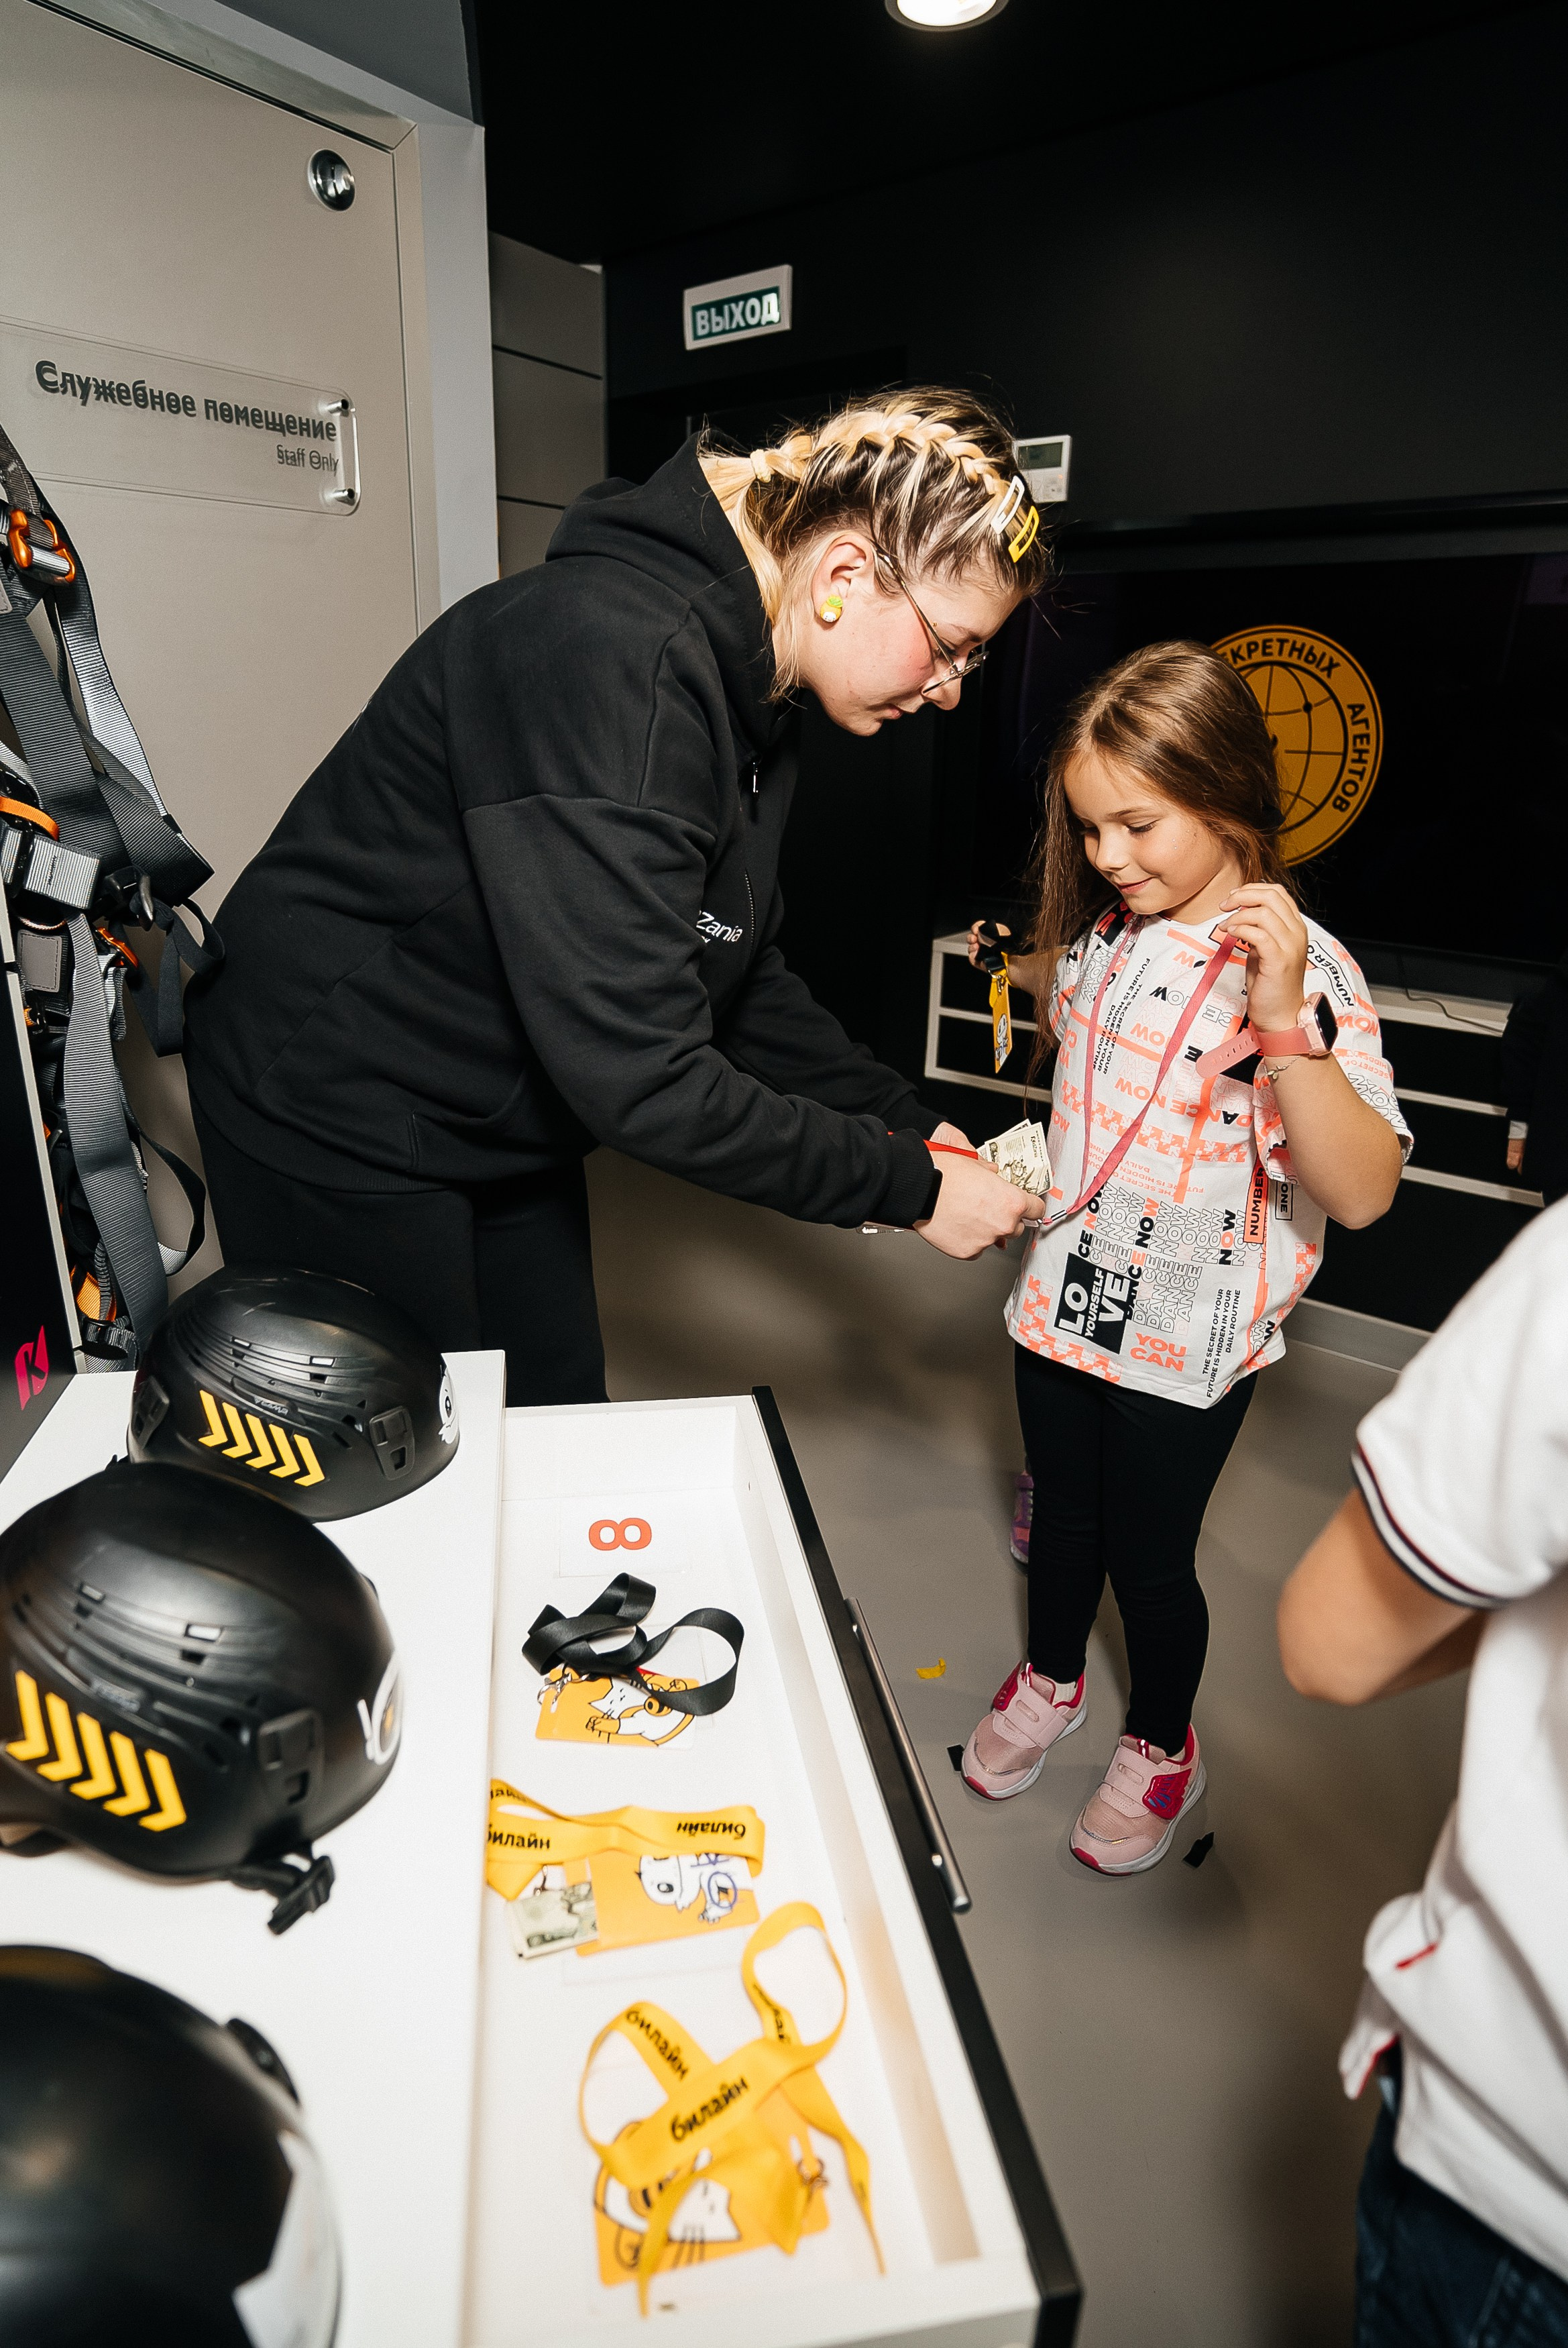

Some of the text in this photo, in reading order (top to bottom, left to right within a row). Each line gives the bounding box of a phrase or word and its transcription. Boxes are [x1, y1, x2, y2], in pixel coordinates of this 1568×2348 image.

[695, 292, 780, 336] ВЫХОД
[35, 360, 337, 442] Служебное помещение
[277, 445, 339, 477] Staff Only
[1221, 638, 1371, 814] КРЕТНЫХ АГЕНТОВ
[696, 911, 743, 943] Zania
[1128, 958, 1151, 992] FUTURE
[1131, 983, 1143, 1000] THE
[1105, 1005, 1115, 1029] DAILY
[1108, 1002, 1125, 1035] HIDDEN
[1115, 1002, 1131, 1036] SECRET
[1097, 1047, 1109, 1071] YOUR
[1103, 1049, 1113, 1075] YOUR
[1250, 1167, 1266, 1236] NUMBER
[1280, 1183, 1288, 1213] ONE
[1219, 1209, 1236, 1265] NOW
[1084, 1268, 1104, 1338] YOURSELF
[1223, 1289, 1232, 1314] YOUR
[1202, 1289, 1224, 1375] THE SECRET OF YOUR
[1225, 1289, 1241, 1353] DAILY ROUTINE
[1135, 1332, 1186, 1357] YOU
[1215, 1325, 1226, 1356] HIDDEN
[1129, 1347, 1184, 1372] CAN
[1213, 1358, 1220, 1367] IS
[1207, 1367, 1218, 1398] FUTURE
[677, 1821, 746, 1841] билайн
[626, 2009, 689, 2080] билайн
[670, 2077, 750, 2141] билайн
